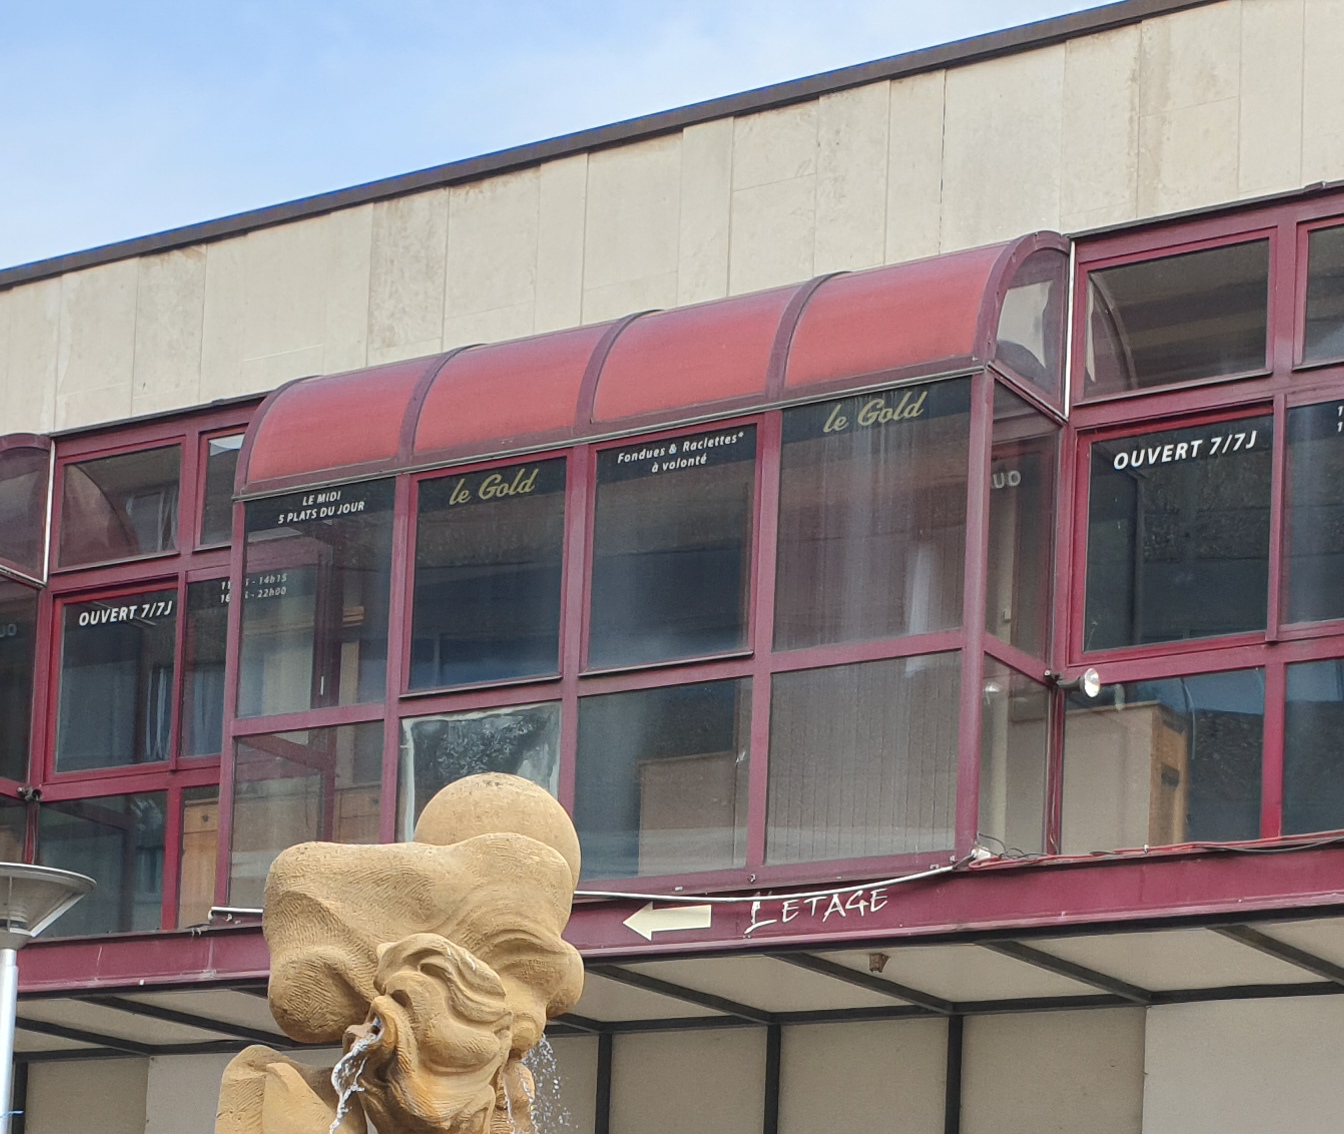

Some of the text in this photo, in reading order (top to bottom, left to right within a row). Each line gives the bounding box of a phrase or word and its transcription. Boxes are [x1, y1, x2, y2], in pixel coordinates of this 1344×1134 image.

[823, 391, 928, 433] le Gold
[617, 447, 666, 464] Fondues
[668, 443, 677, 455] &
[662, 452, 707, 472] volonté
[1113, 430, 1257, 470] OUVERT 7/7J
[302, 490, 342, 506] LE MIDI
[449, 468, 539, 505] le Gold
[278, 501, 365, 524] 5 PLATS DU JOUR
[79, 600, 173, 626] OUVERT 7/7J
